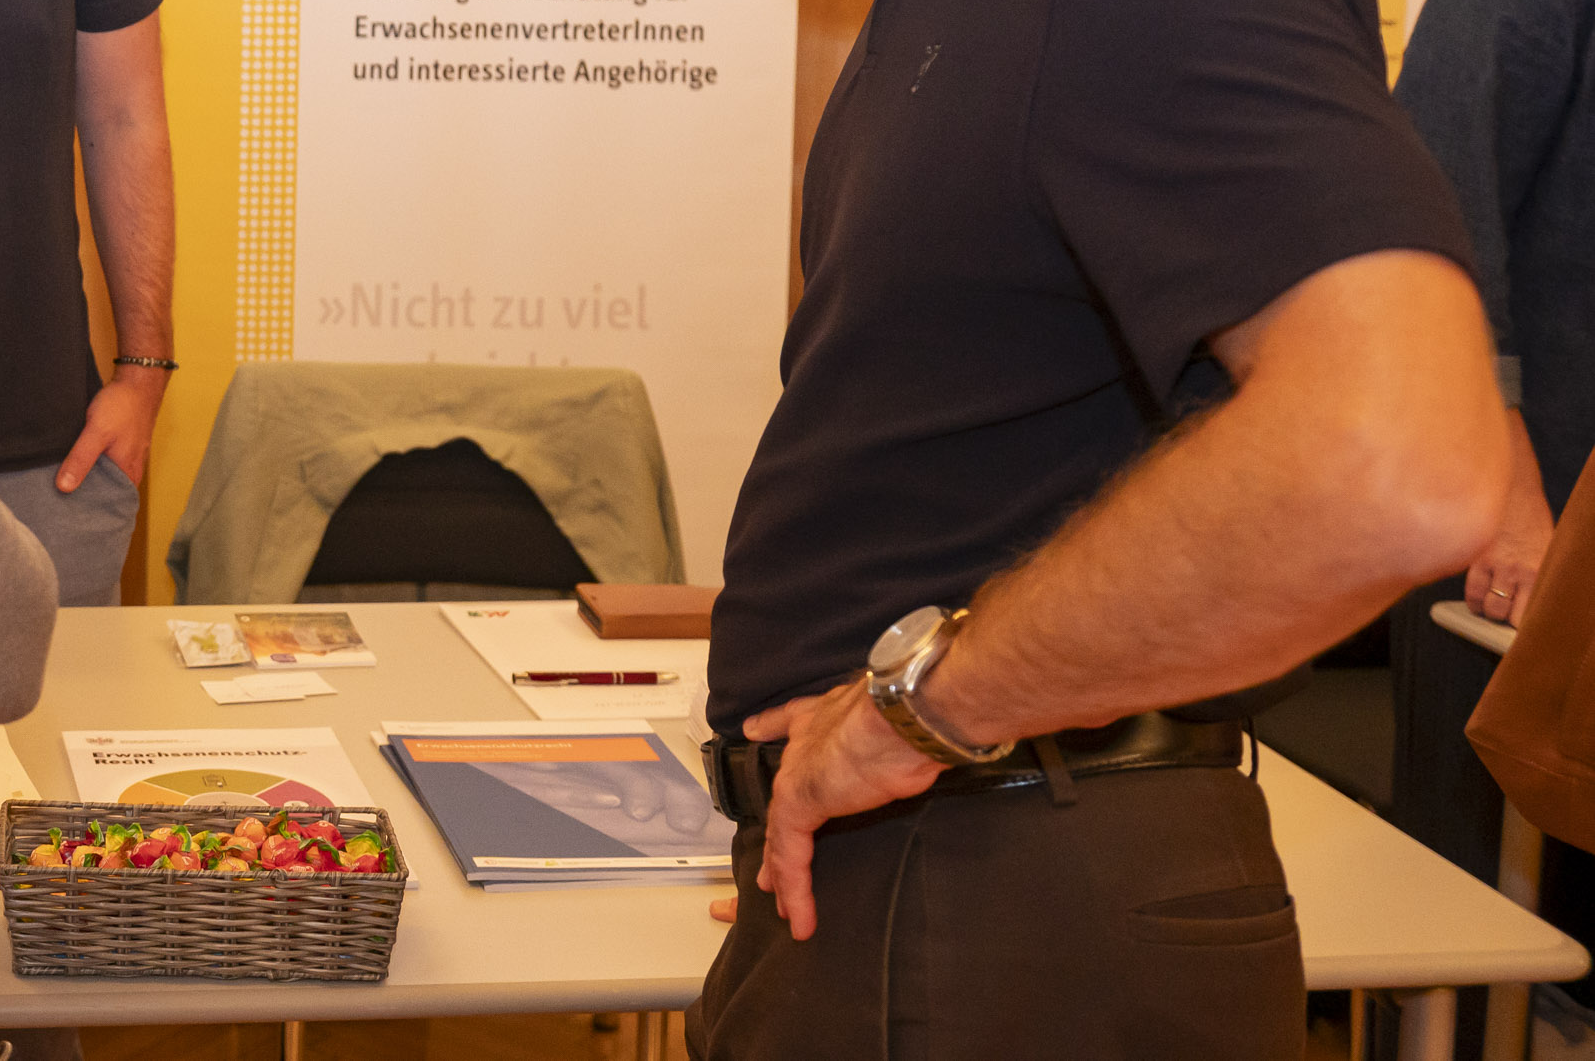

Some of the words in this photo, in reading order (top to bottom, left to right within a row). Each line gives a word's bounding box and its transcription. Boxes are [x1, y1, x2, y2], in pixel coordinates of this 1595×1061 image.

[355, 15, 705, 42] ErwachsenenvertreterInnen
[353, 57, 399, 81] und
[409, 57, 566, 83] interessierte
[573, 58, 718, 90] Angehörige
[490, 293, 545, 329] zu
[563, 283, 651, 331] viel
[92, 749, 308, 758] Erwachsenenschutz-
